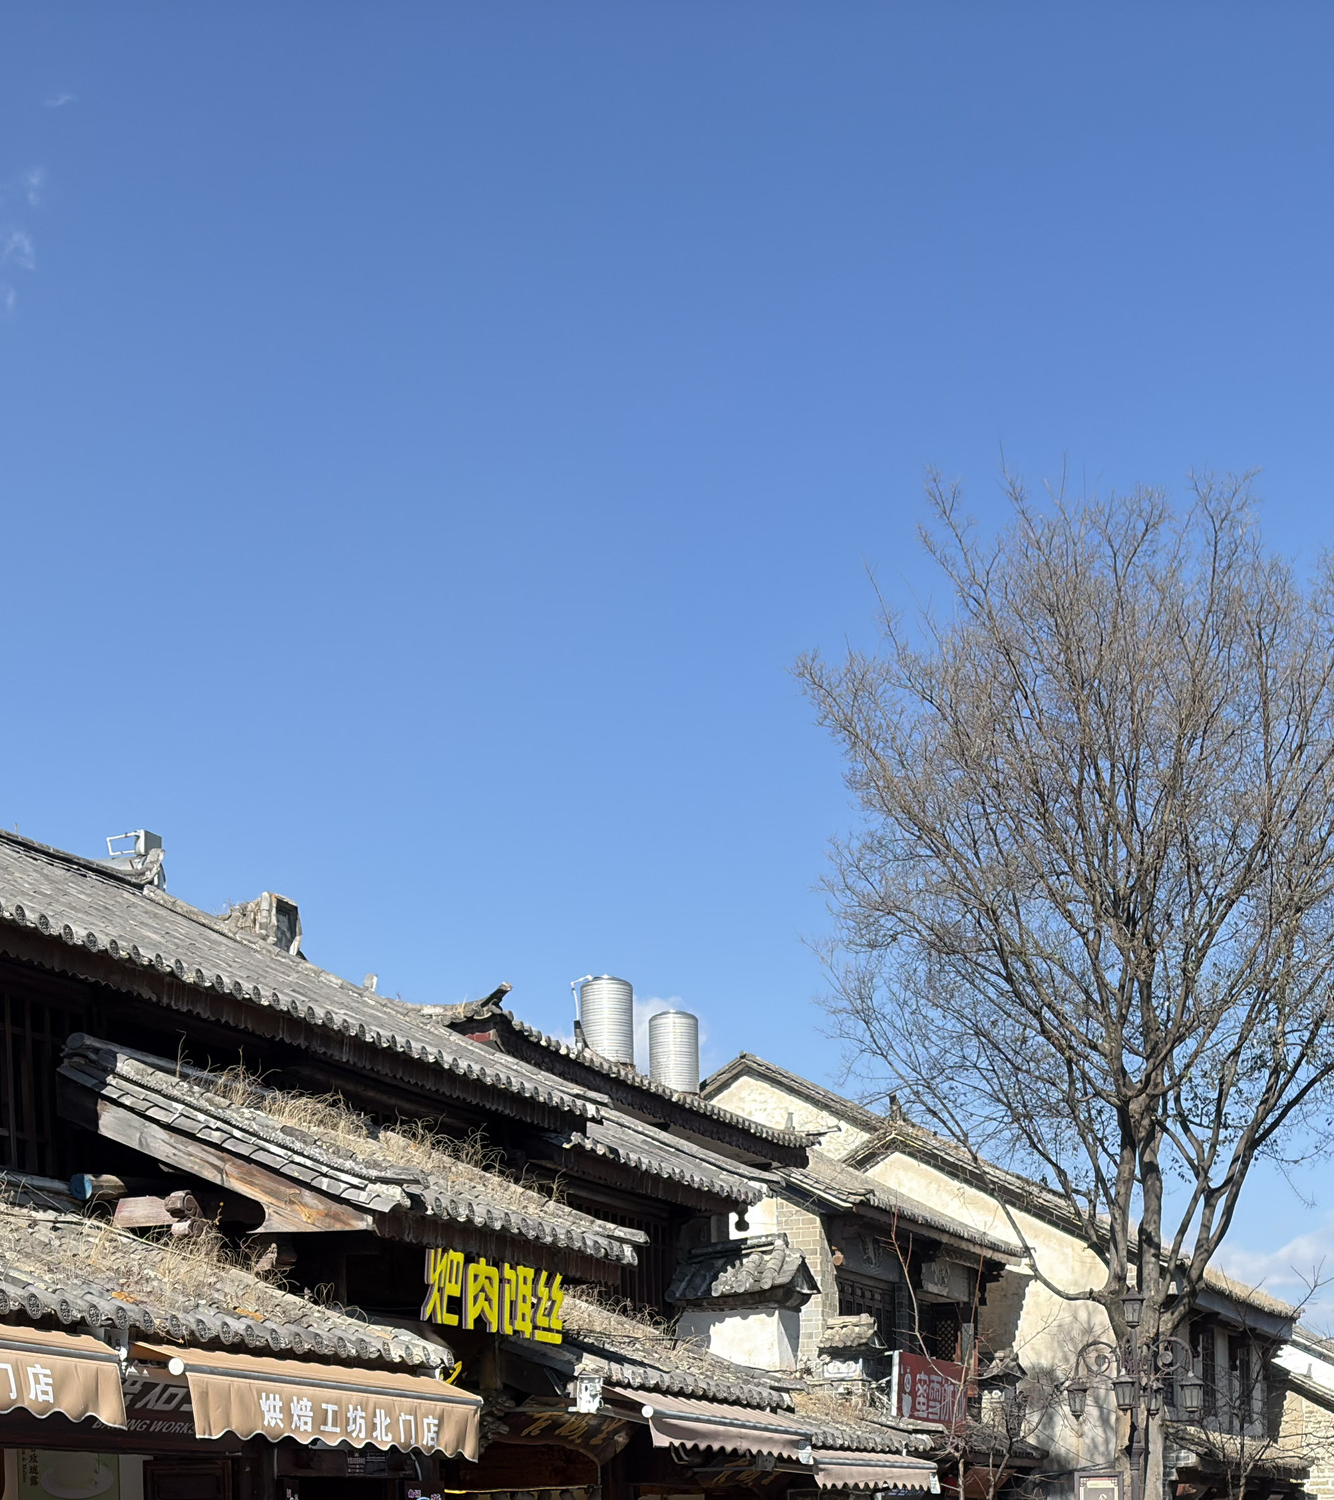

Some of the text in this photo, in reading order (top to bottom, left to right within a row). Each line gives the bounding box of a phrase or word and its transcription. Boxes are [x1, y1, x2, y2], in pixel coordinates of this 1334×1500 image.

[259, 1392, 440, 1447] 烘焙工坊北门店
